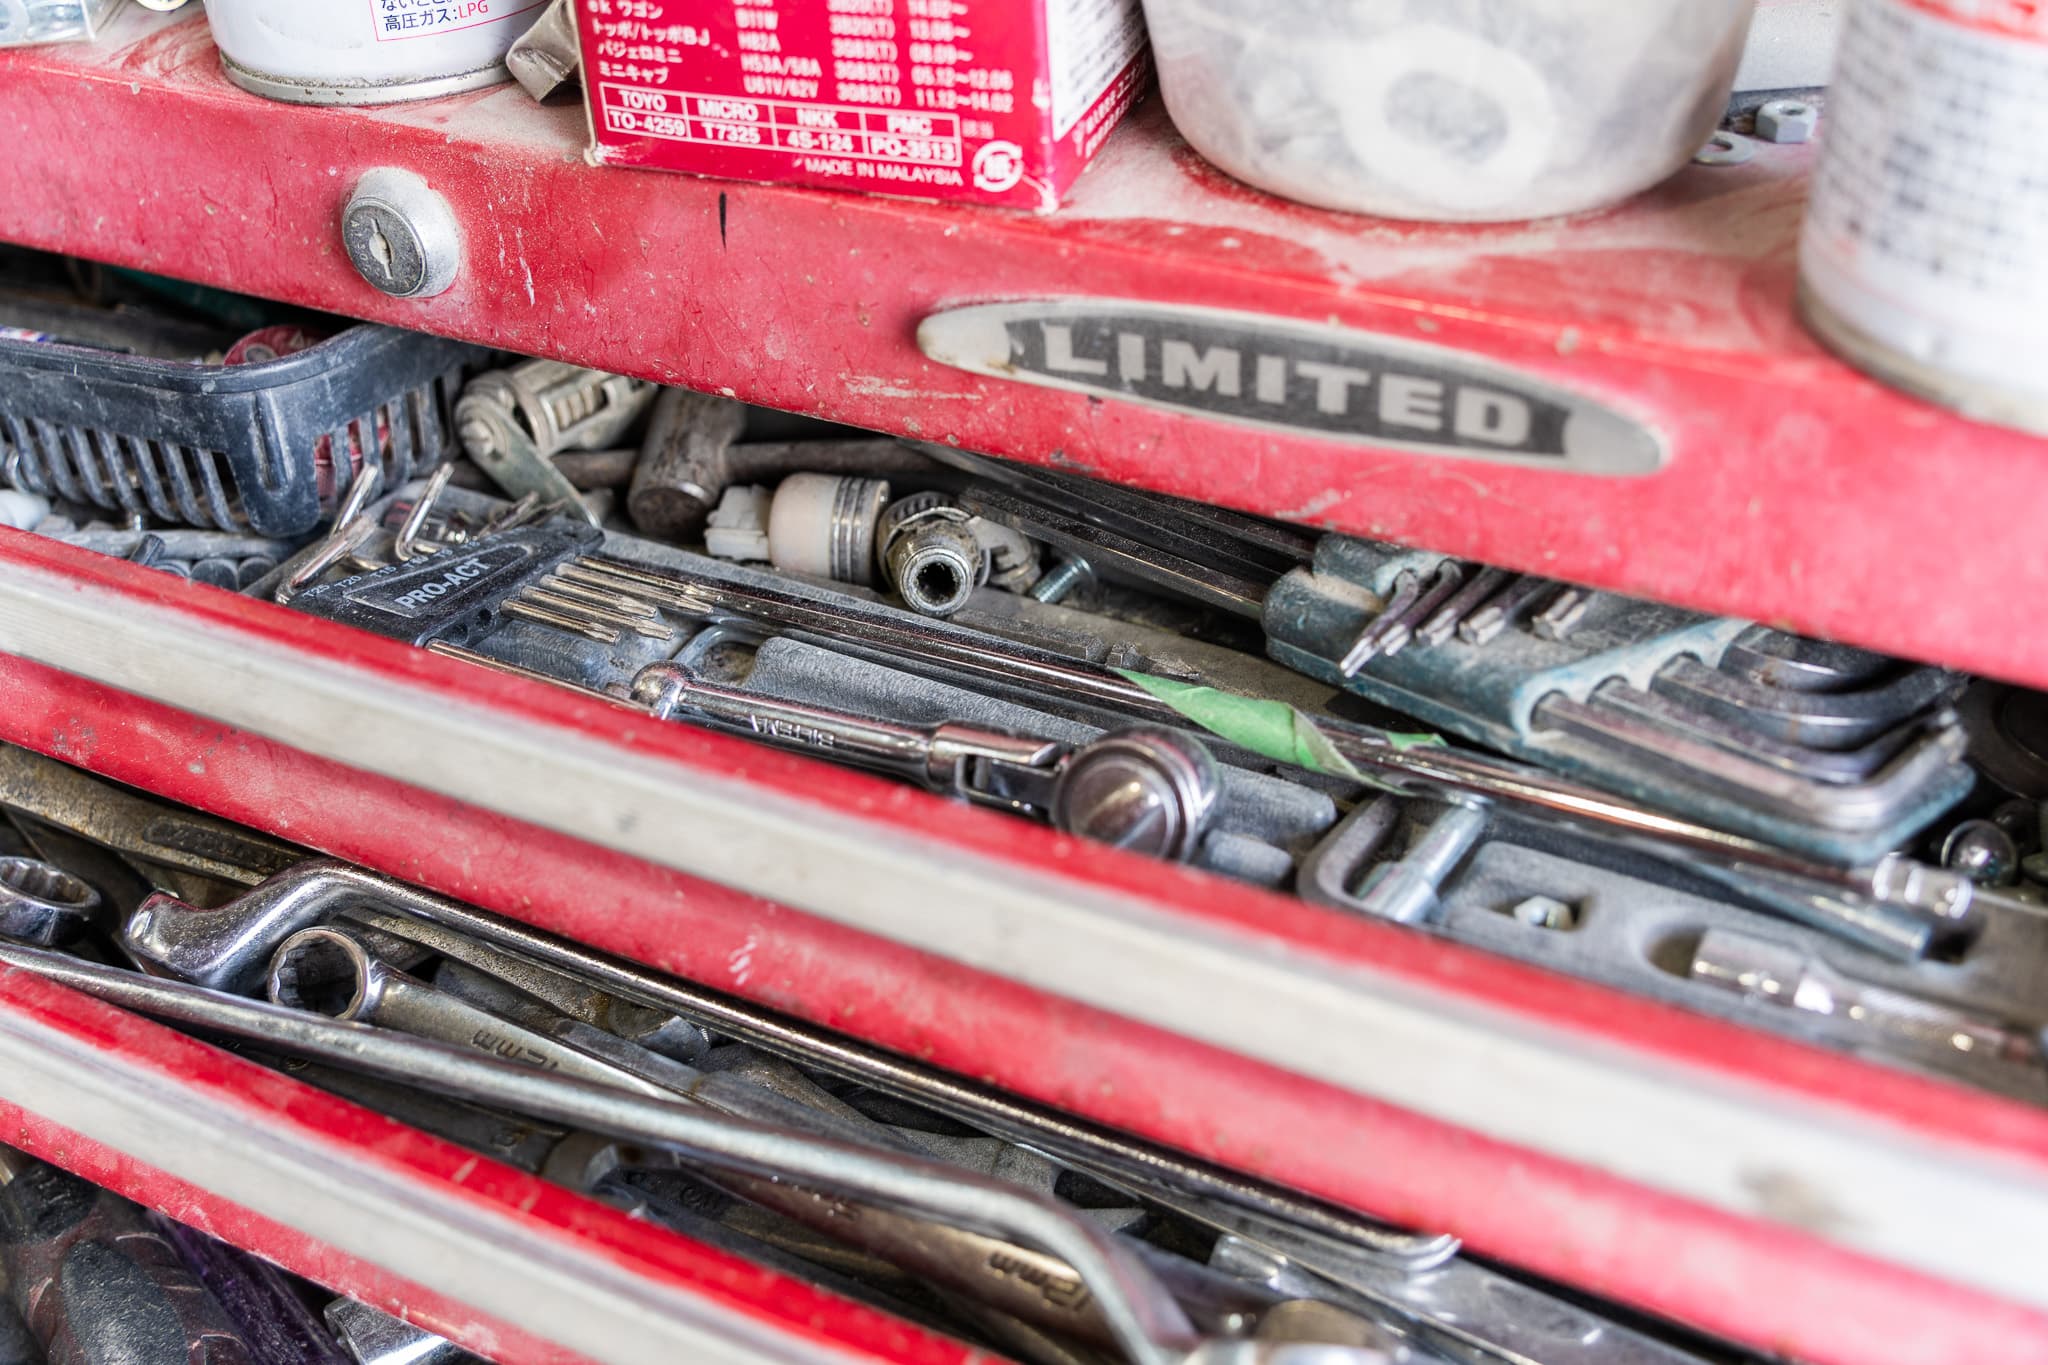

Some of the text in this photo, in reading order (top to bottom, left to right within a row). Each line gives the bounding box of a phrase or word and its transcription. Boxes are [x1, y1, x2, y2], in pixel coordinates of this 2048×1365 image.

[616, 0, 664, 19] ワゴン
[609, 110, 956, 161] TO-4259 T7325 4S-124 PO-3513
[618, 89, 933, 137] TOYO MICRO NKK PMC
[803, 157, 853, 177] MADE
[855, 162, 875, 178] IN
[876, 163, 964, 187] MALAYSIA
[1043, 323, 1530, 446] LIMITED
[302, 583, 331, 599] T25
[334, 575, 362, 590] T20
[394, 557, 491, 610] PRO-ACT
